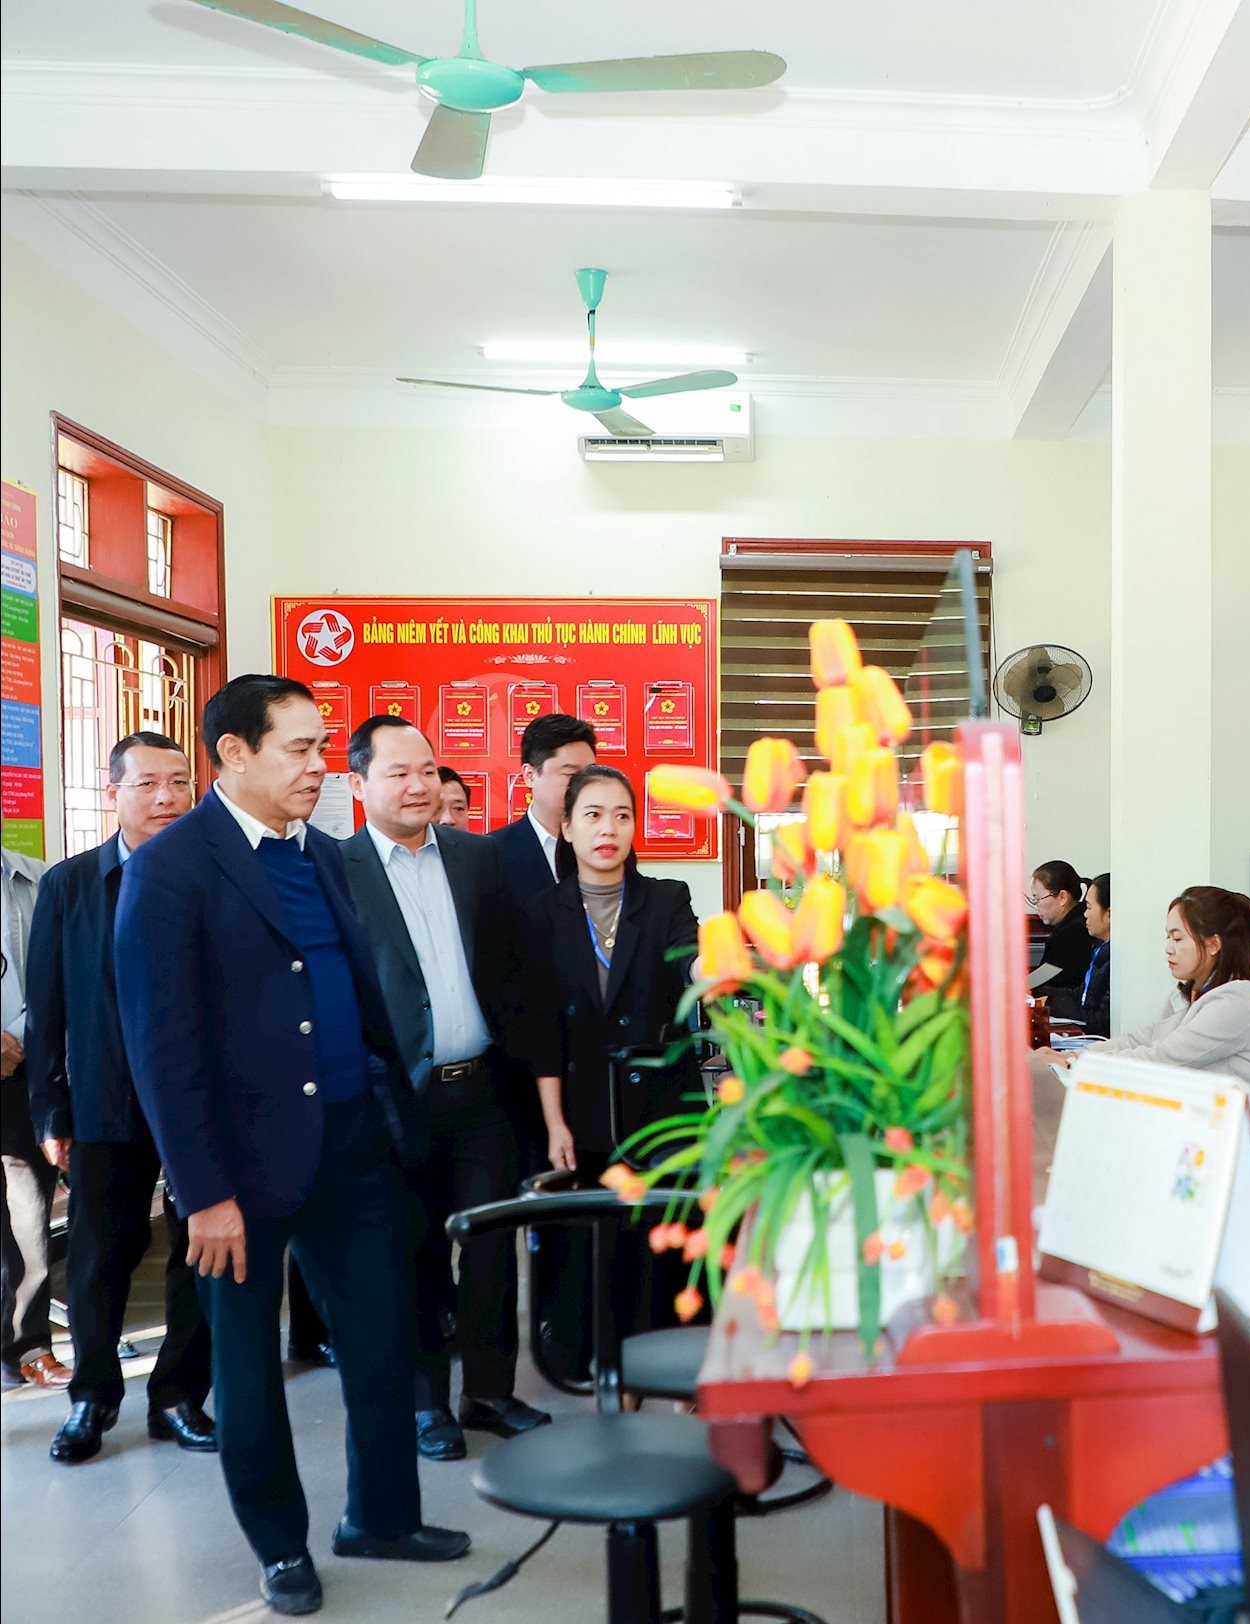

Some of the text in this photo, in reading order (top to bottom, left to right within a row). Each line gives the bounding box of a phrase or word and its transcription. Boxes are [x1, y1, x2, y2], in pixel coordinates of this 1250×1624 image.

[363, 616, 702, 649] BẢNG NIÊM YẾT VÀ CÔNG KHAI THỦ TỤC HÀNH CHÍNH LĨNH VỰC
